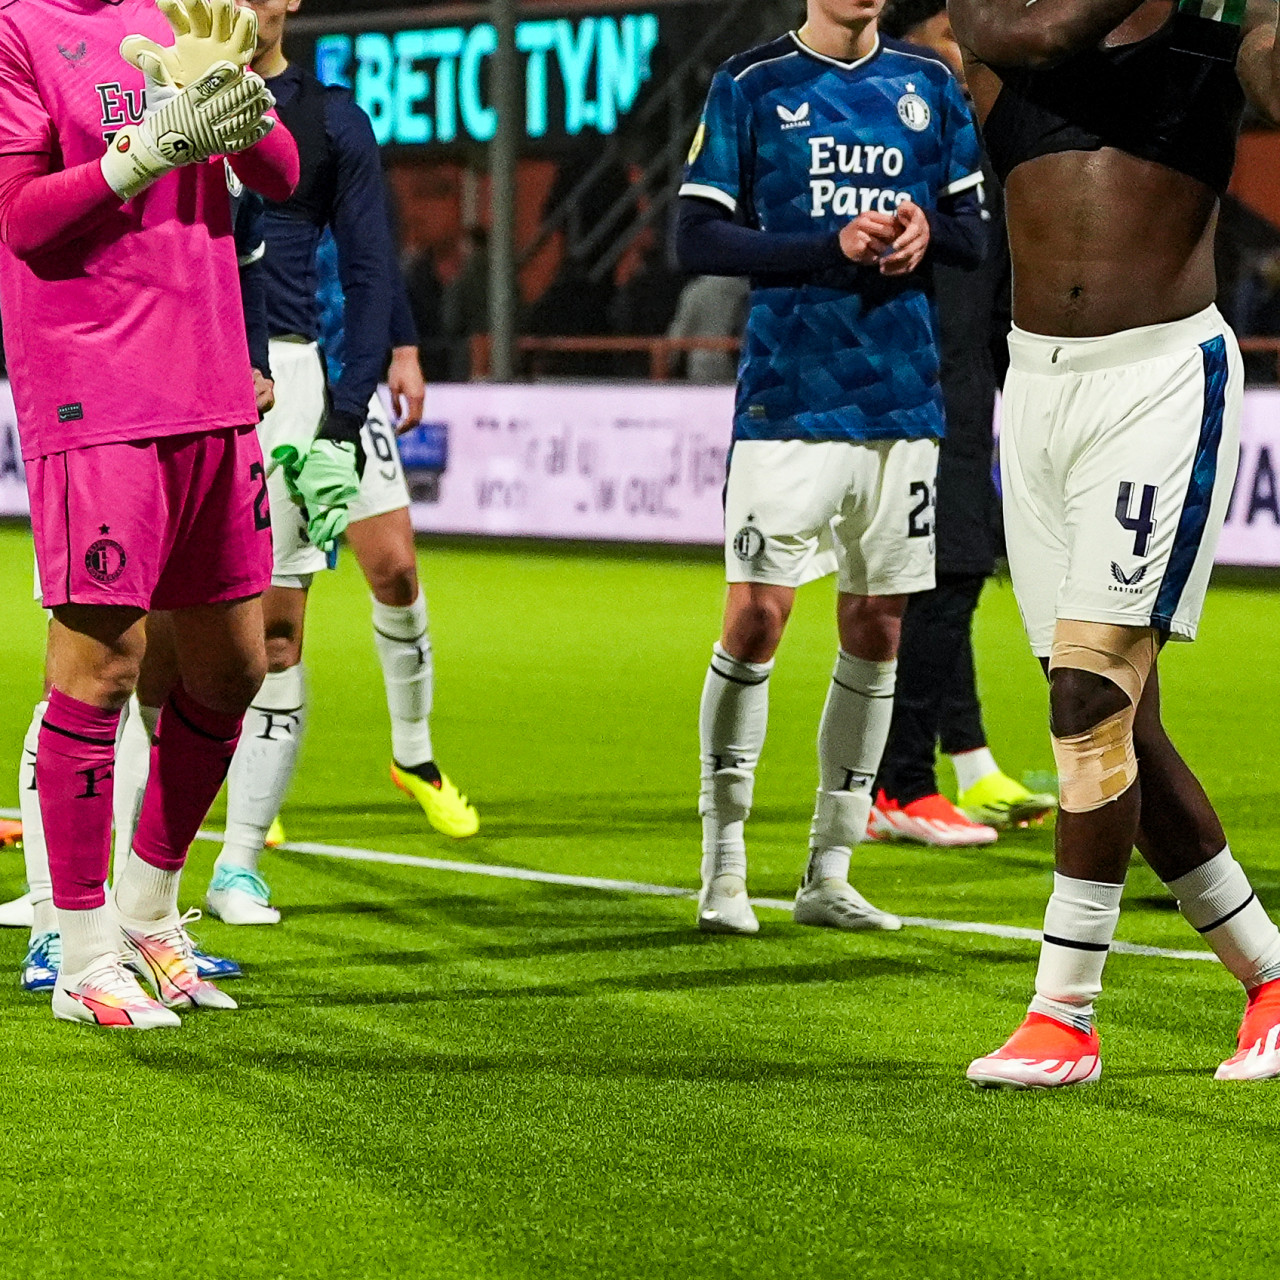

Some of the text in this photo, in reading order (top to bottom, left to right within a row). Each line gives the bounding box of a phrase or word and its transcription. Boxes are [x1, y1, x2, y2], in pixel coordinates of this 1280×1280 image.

[808, 136, 904, 177] Euro
[1114, 480, 1159, 558] 4
[1107, 585, 1144, 596] CASTORE
[259, 713, 300, 741] F
[74, 762, 113, 799] F
